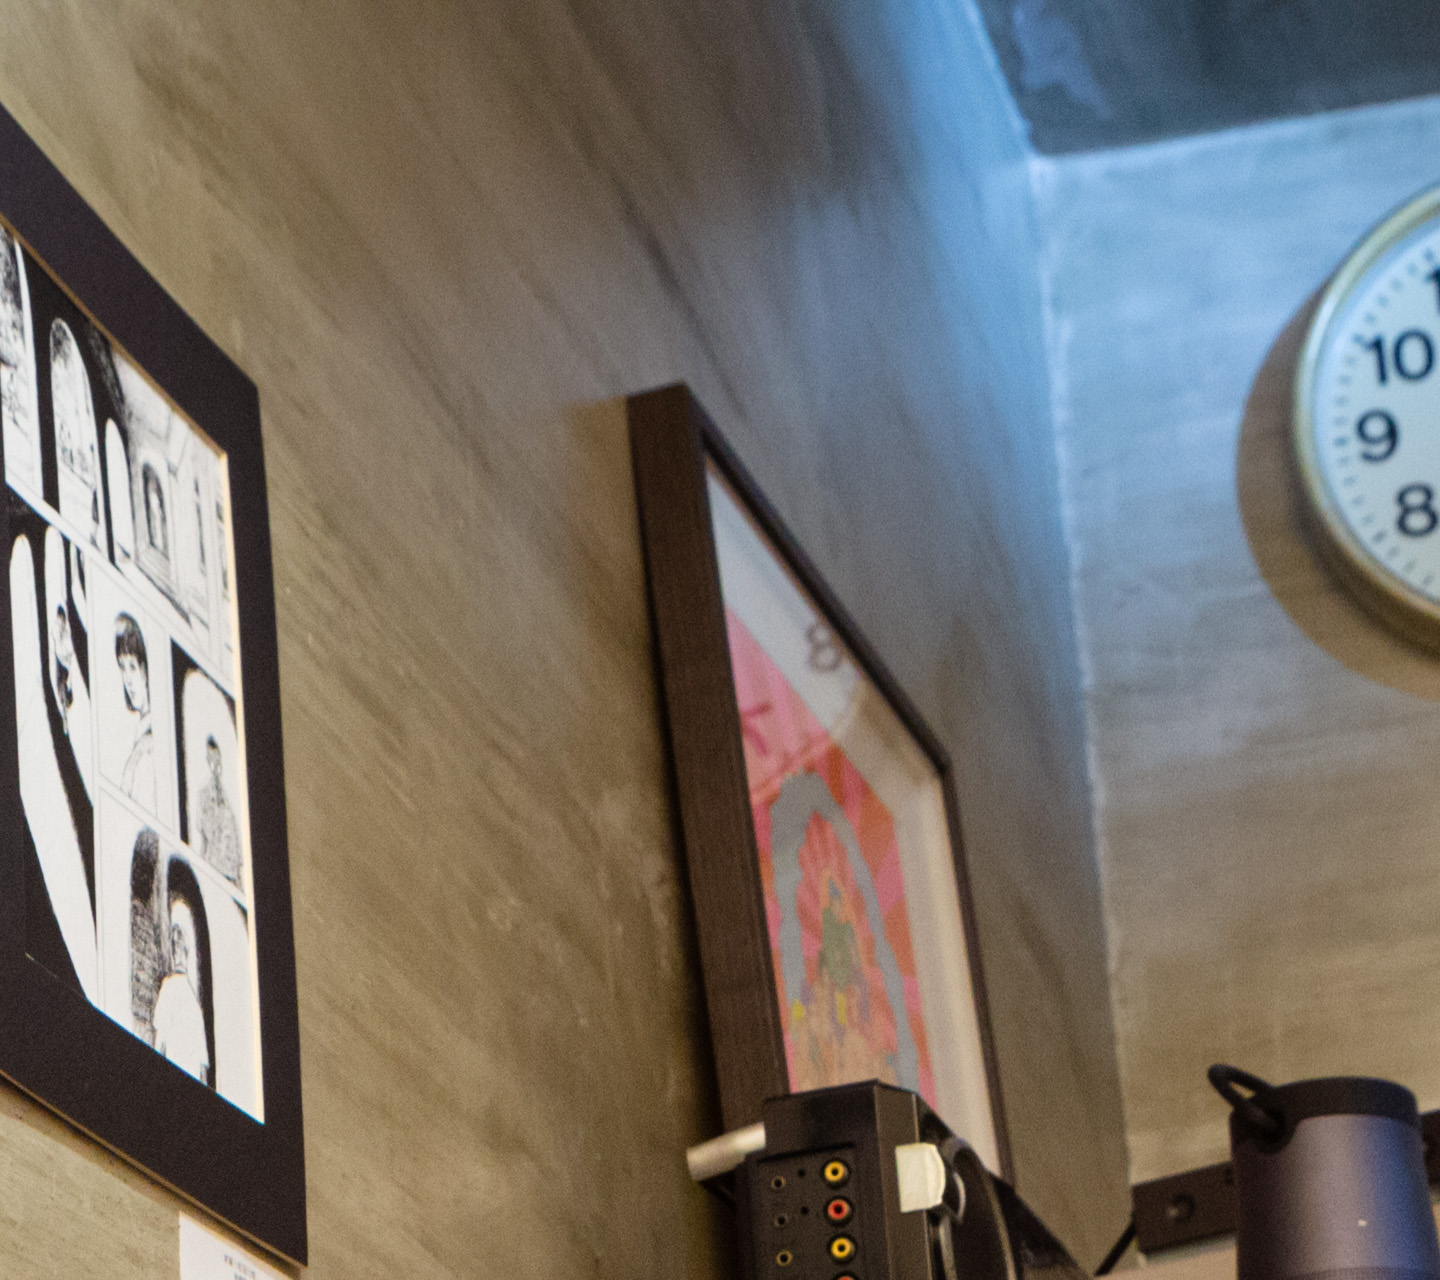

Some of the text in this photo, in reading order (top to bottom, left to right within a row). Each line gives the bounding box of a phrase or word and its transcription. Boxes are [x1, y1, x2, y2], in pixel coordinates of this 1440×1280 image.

[1368, 329, 1435, 384] 10
[1356, 410, 1400, 463] 9
[1395, 485, 1440, 537] 8
